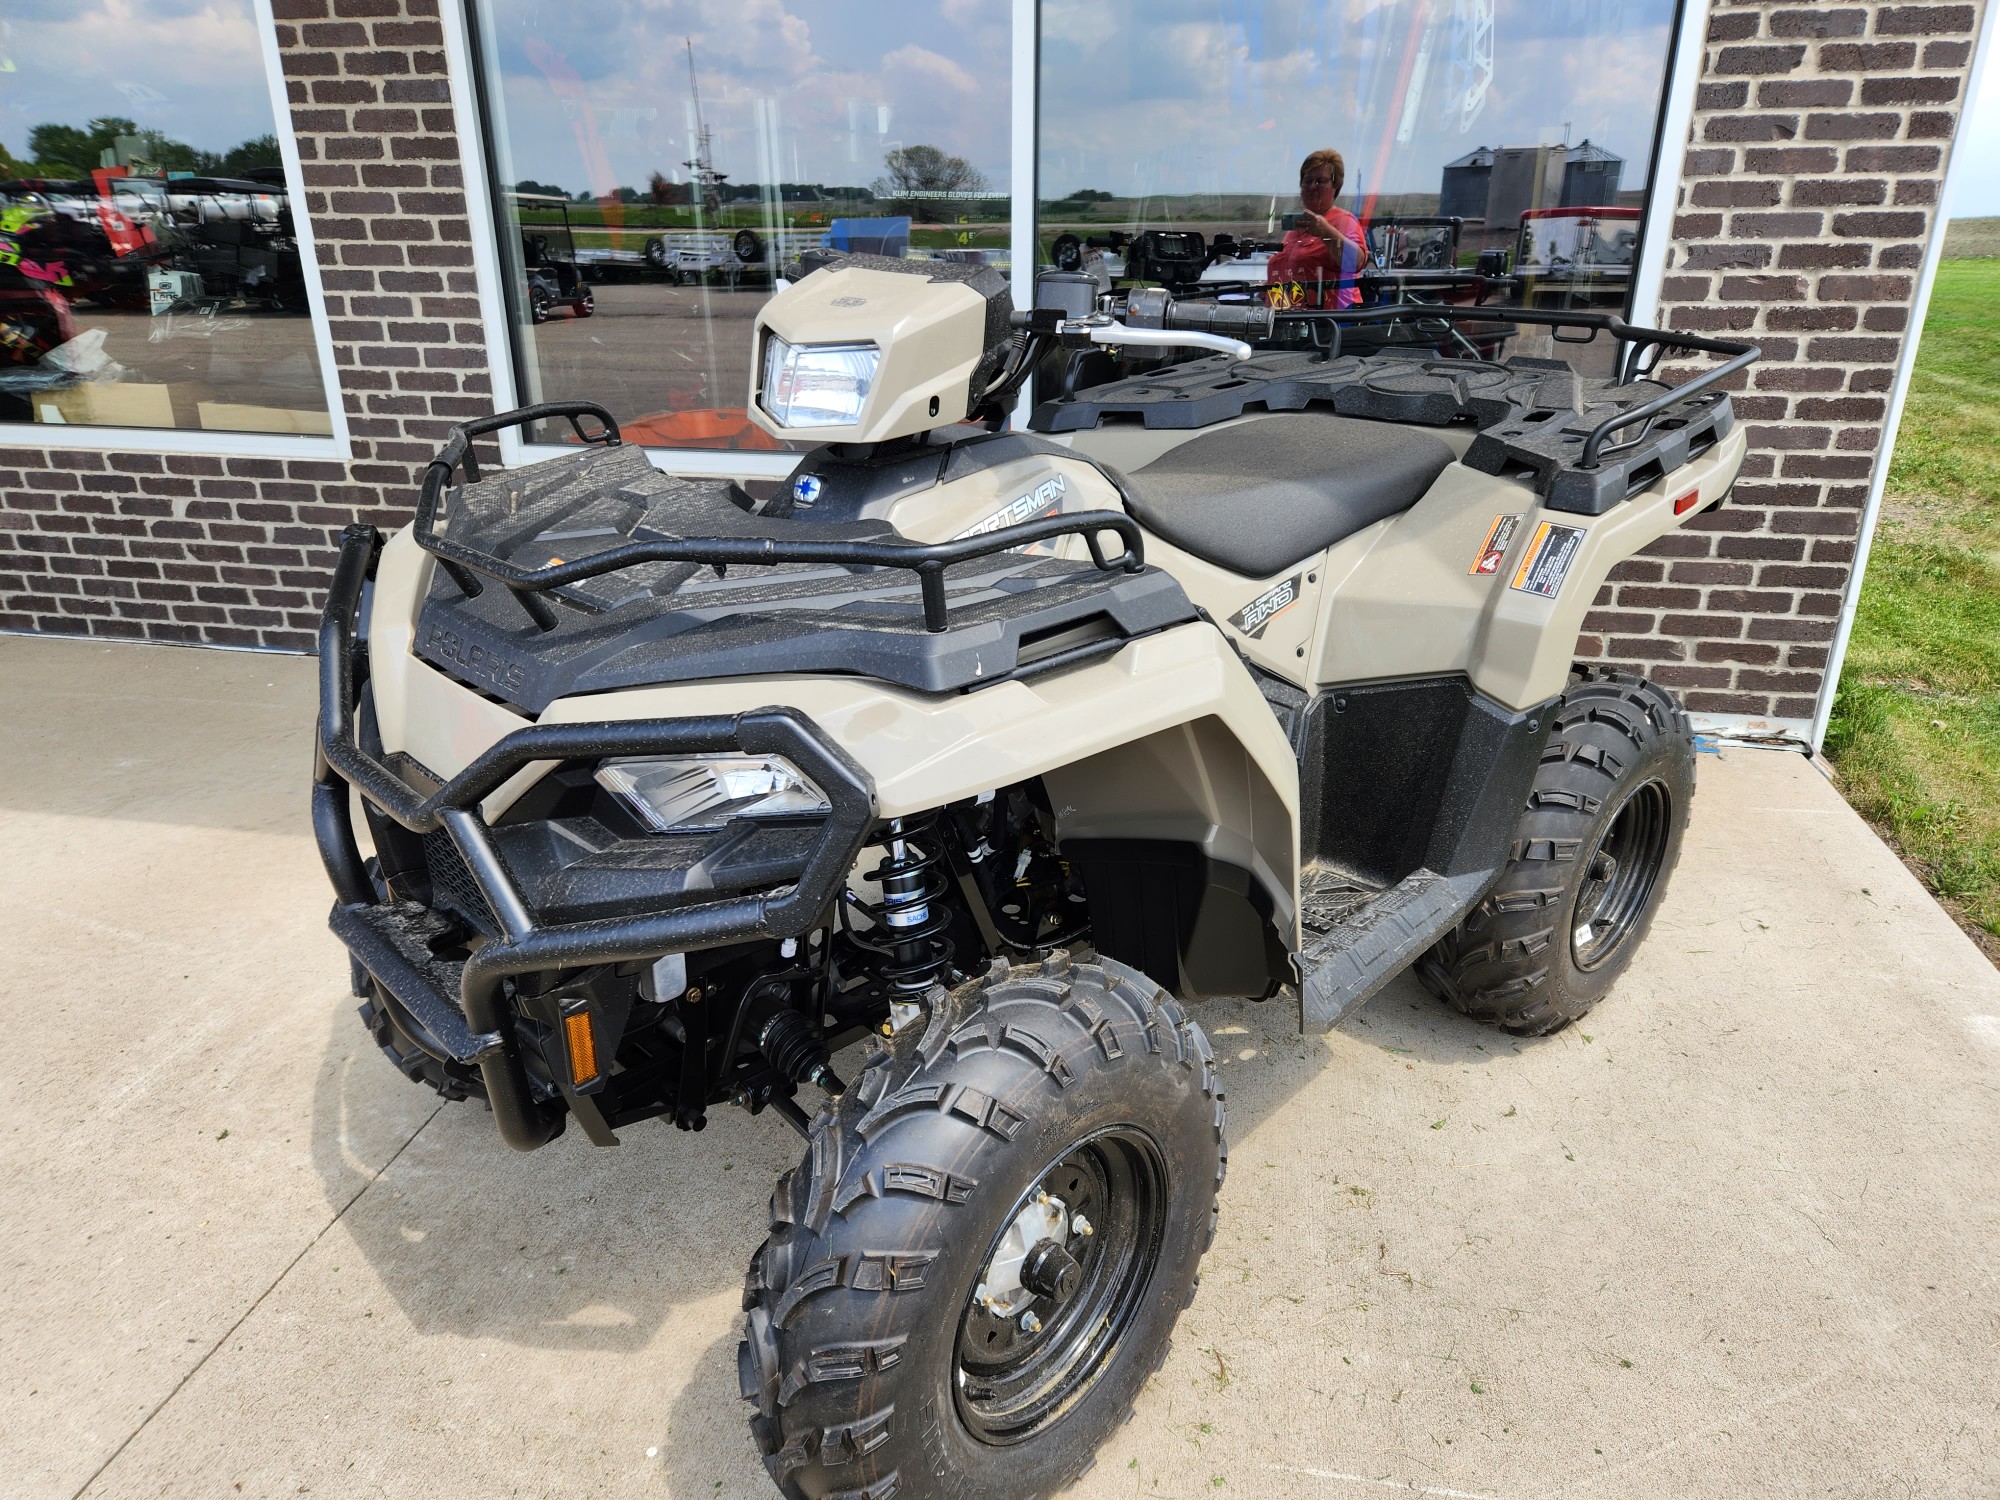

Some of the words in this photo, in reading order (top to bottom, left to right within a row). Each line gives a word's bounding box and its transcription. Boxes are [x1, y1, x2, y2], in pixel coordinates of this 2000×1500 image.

[910, 190, 947, 198] ENGINEERS
[948, 191, 972, 199] GLOVES
[153, 291, 179, 302] Lens
[1244, 587, 1294, 631] AWD
[426, 623, 526, 694] POLARIS
